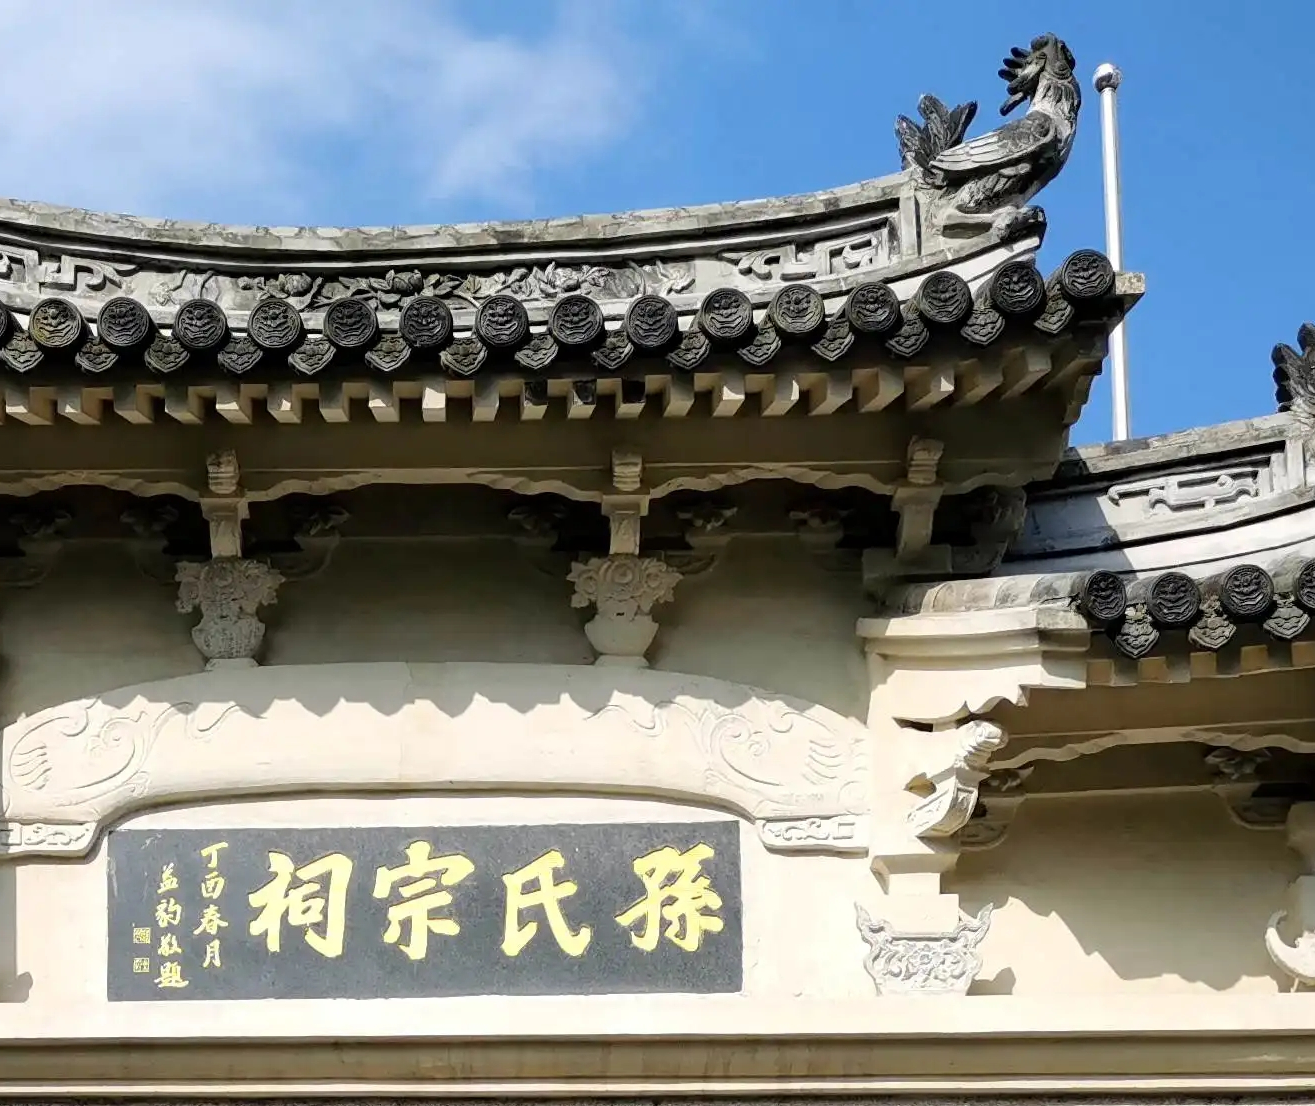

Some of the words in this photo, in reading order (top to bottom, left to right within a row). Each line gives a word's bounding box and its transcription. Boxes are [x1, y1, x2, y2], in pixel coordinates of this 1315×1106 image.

[193, 841, 229, 968] 丁酉春月
[249, 841, 726, 961] 孫氏宗祠
